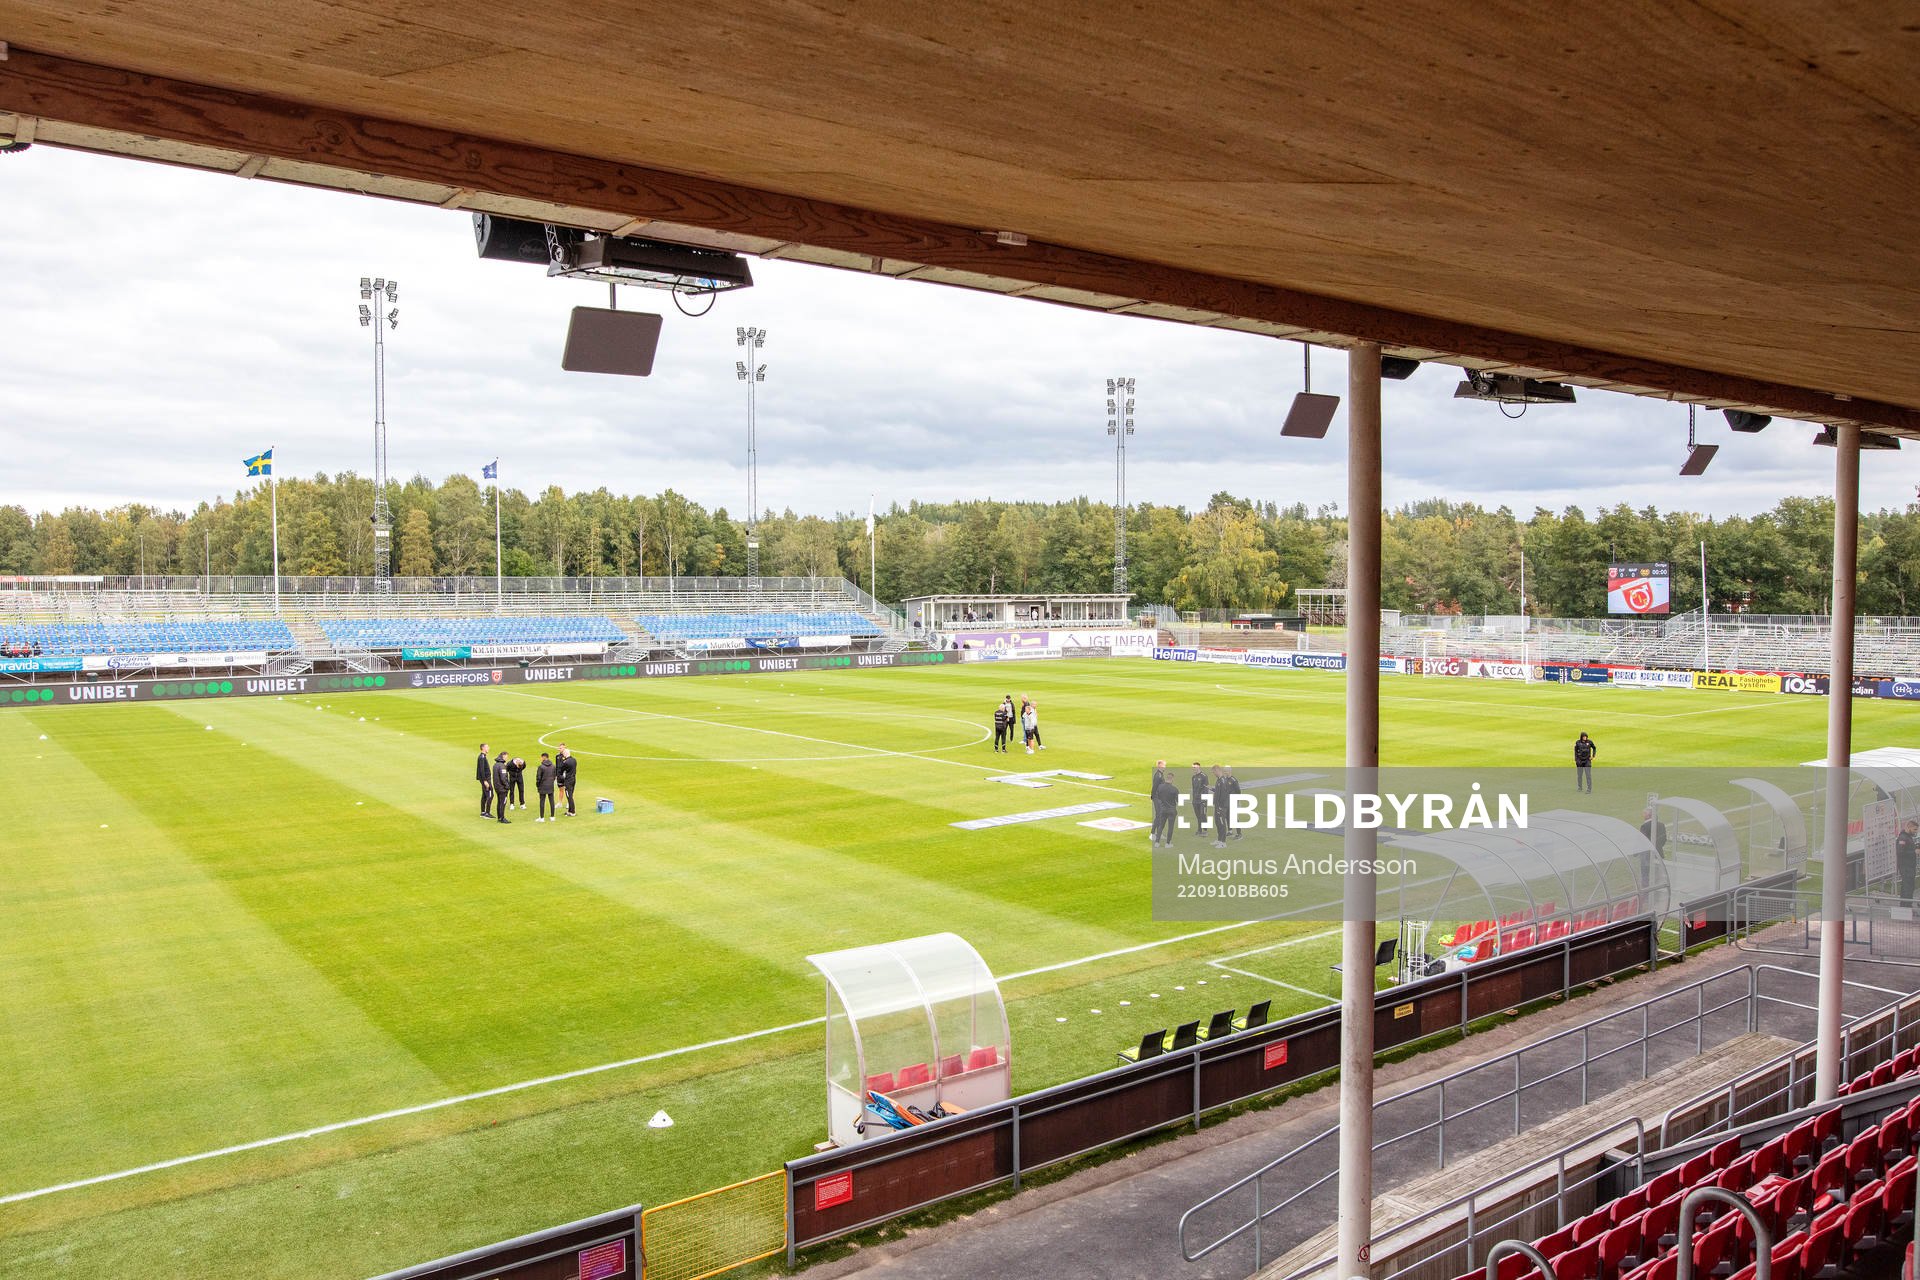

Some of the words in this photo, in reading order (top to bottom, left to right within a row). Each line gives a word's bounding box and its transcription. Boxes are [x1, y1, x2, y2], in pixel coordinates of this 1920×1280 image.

[1115, 635, 1155, 647] INFRA
[413, 648, 457, 659] Assemblin
[1153, 648, 1196, 661] Helmia
[1244, 653, 1292, 665] Vänerbuss
[759, 658, 799, 670] UNIBET
[857, 654, 895, 666] UNIBET
[1294, 655, 1343, 669] Caverion
[524, 667, 574, 681] UNIBET
[645, 662, 691, 676] UNIBET
[1424, 662, 1460, 675] BYGG
[1491, 664, 1525, 677] TECCA
[426, 672, 490, 684] DEGERFORS
[1697, 675, 1738, 687] REAL
[1739, 676, 1777, 684] Fastighets-
[246, 677, 308, 693] UNIBET
[69, 684, 139, 701] UNIBET
